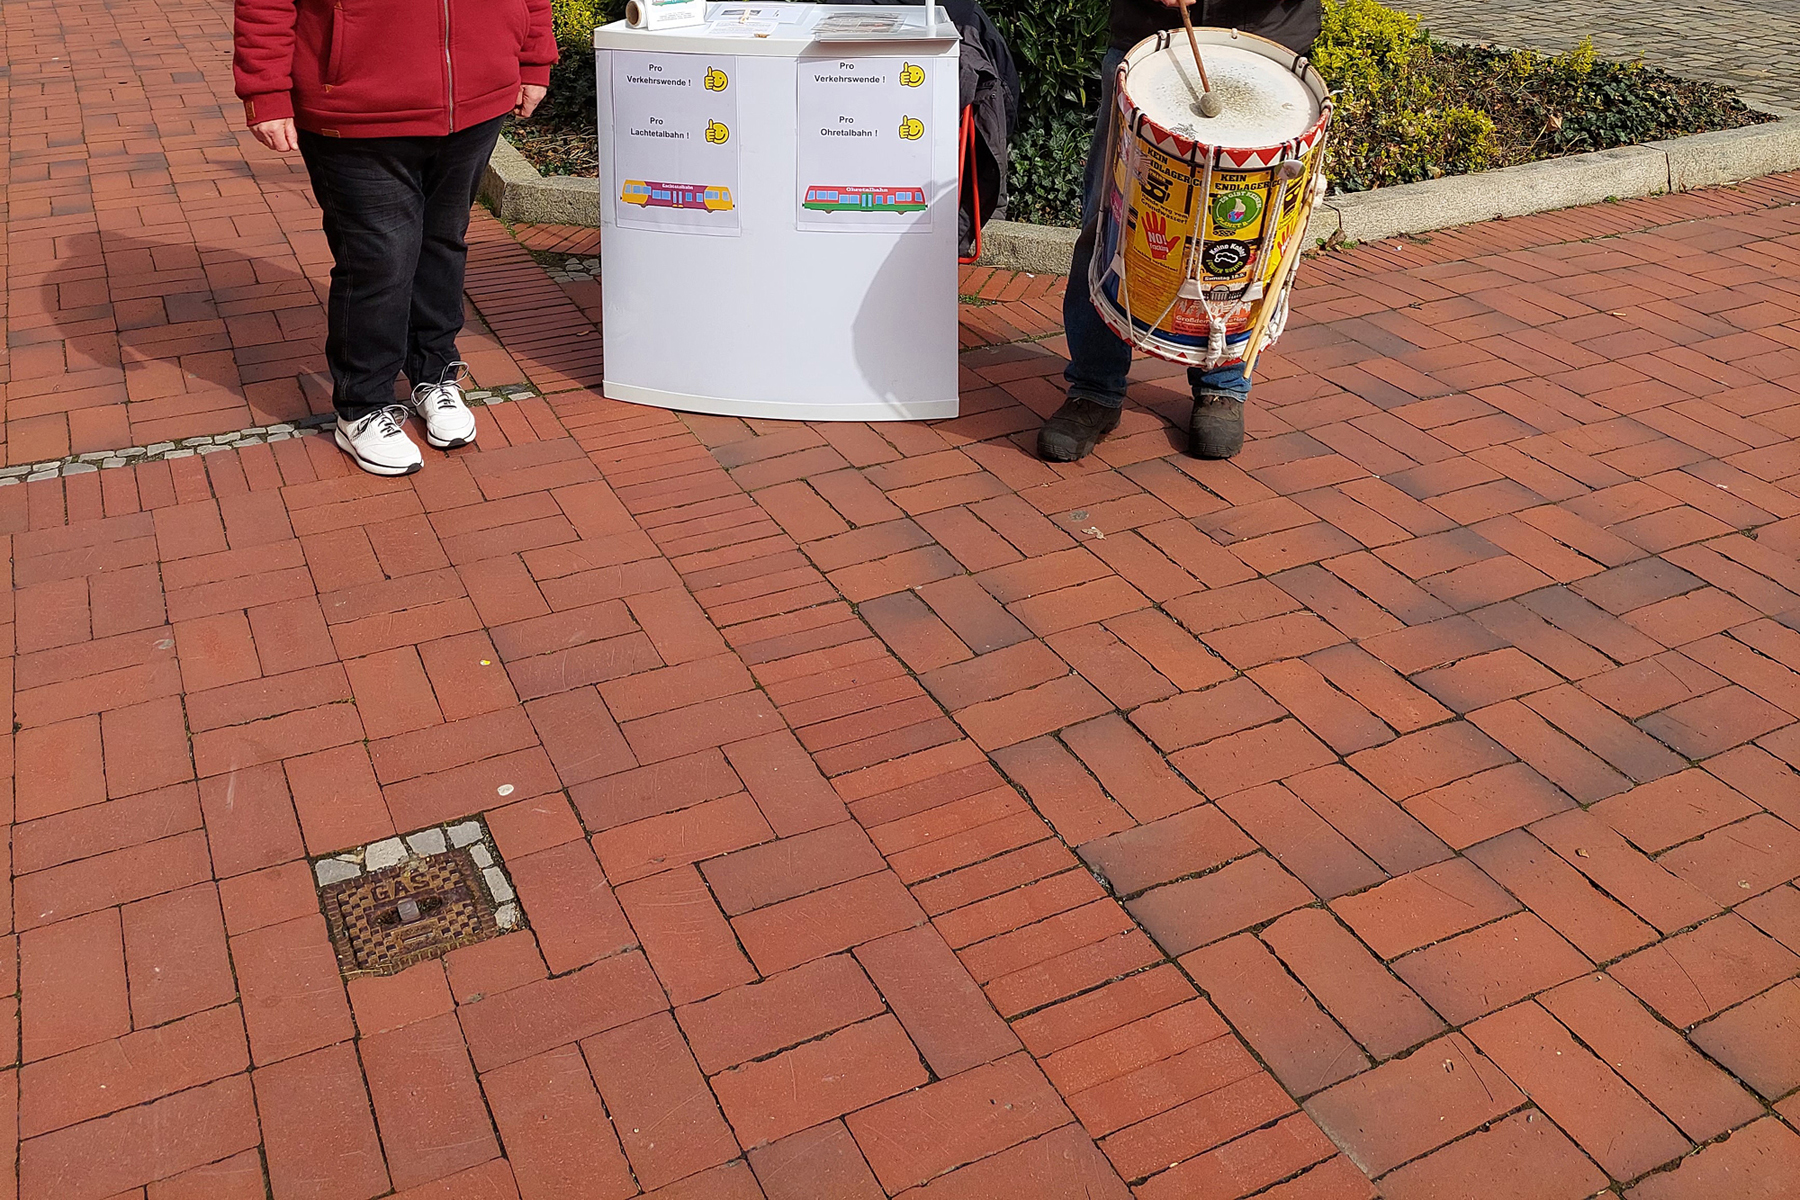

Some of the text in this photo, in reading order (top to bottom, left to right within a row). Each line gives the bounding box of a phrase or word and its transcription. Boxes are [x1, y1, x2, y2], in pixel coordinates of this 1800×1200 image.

[648, 64, 663, 72] Pro
[839, 62, 855, 70] Pro
[626, 75, 687, 87] Verkehrswende
[814, 75, 881, 84] Verkehrswende
[649, 117, 664, 126] Pro
[838, 116, 854, 124] Pro
[630, 128, 685, 139] Lachtetalbahn
[820, 128, 873, 137] Ohretalbahn
[1147, 146, 1169, 165] KEIN
[1220, 173, 1247, 182] KEIN
[1214, 180, 1270, 191] ENDLAGER
[1148, 231, 1168, 246] NO!
[371, 873, 430, 901] GAS
